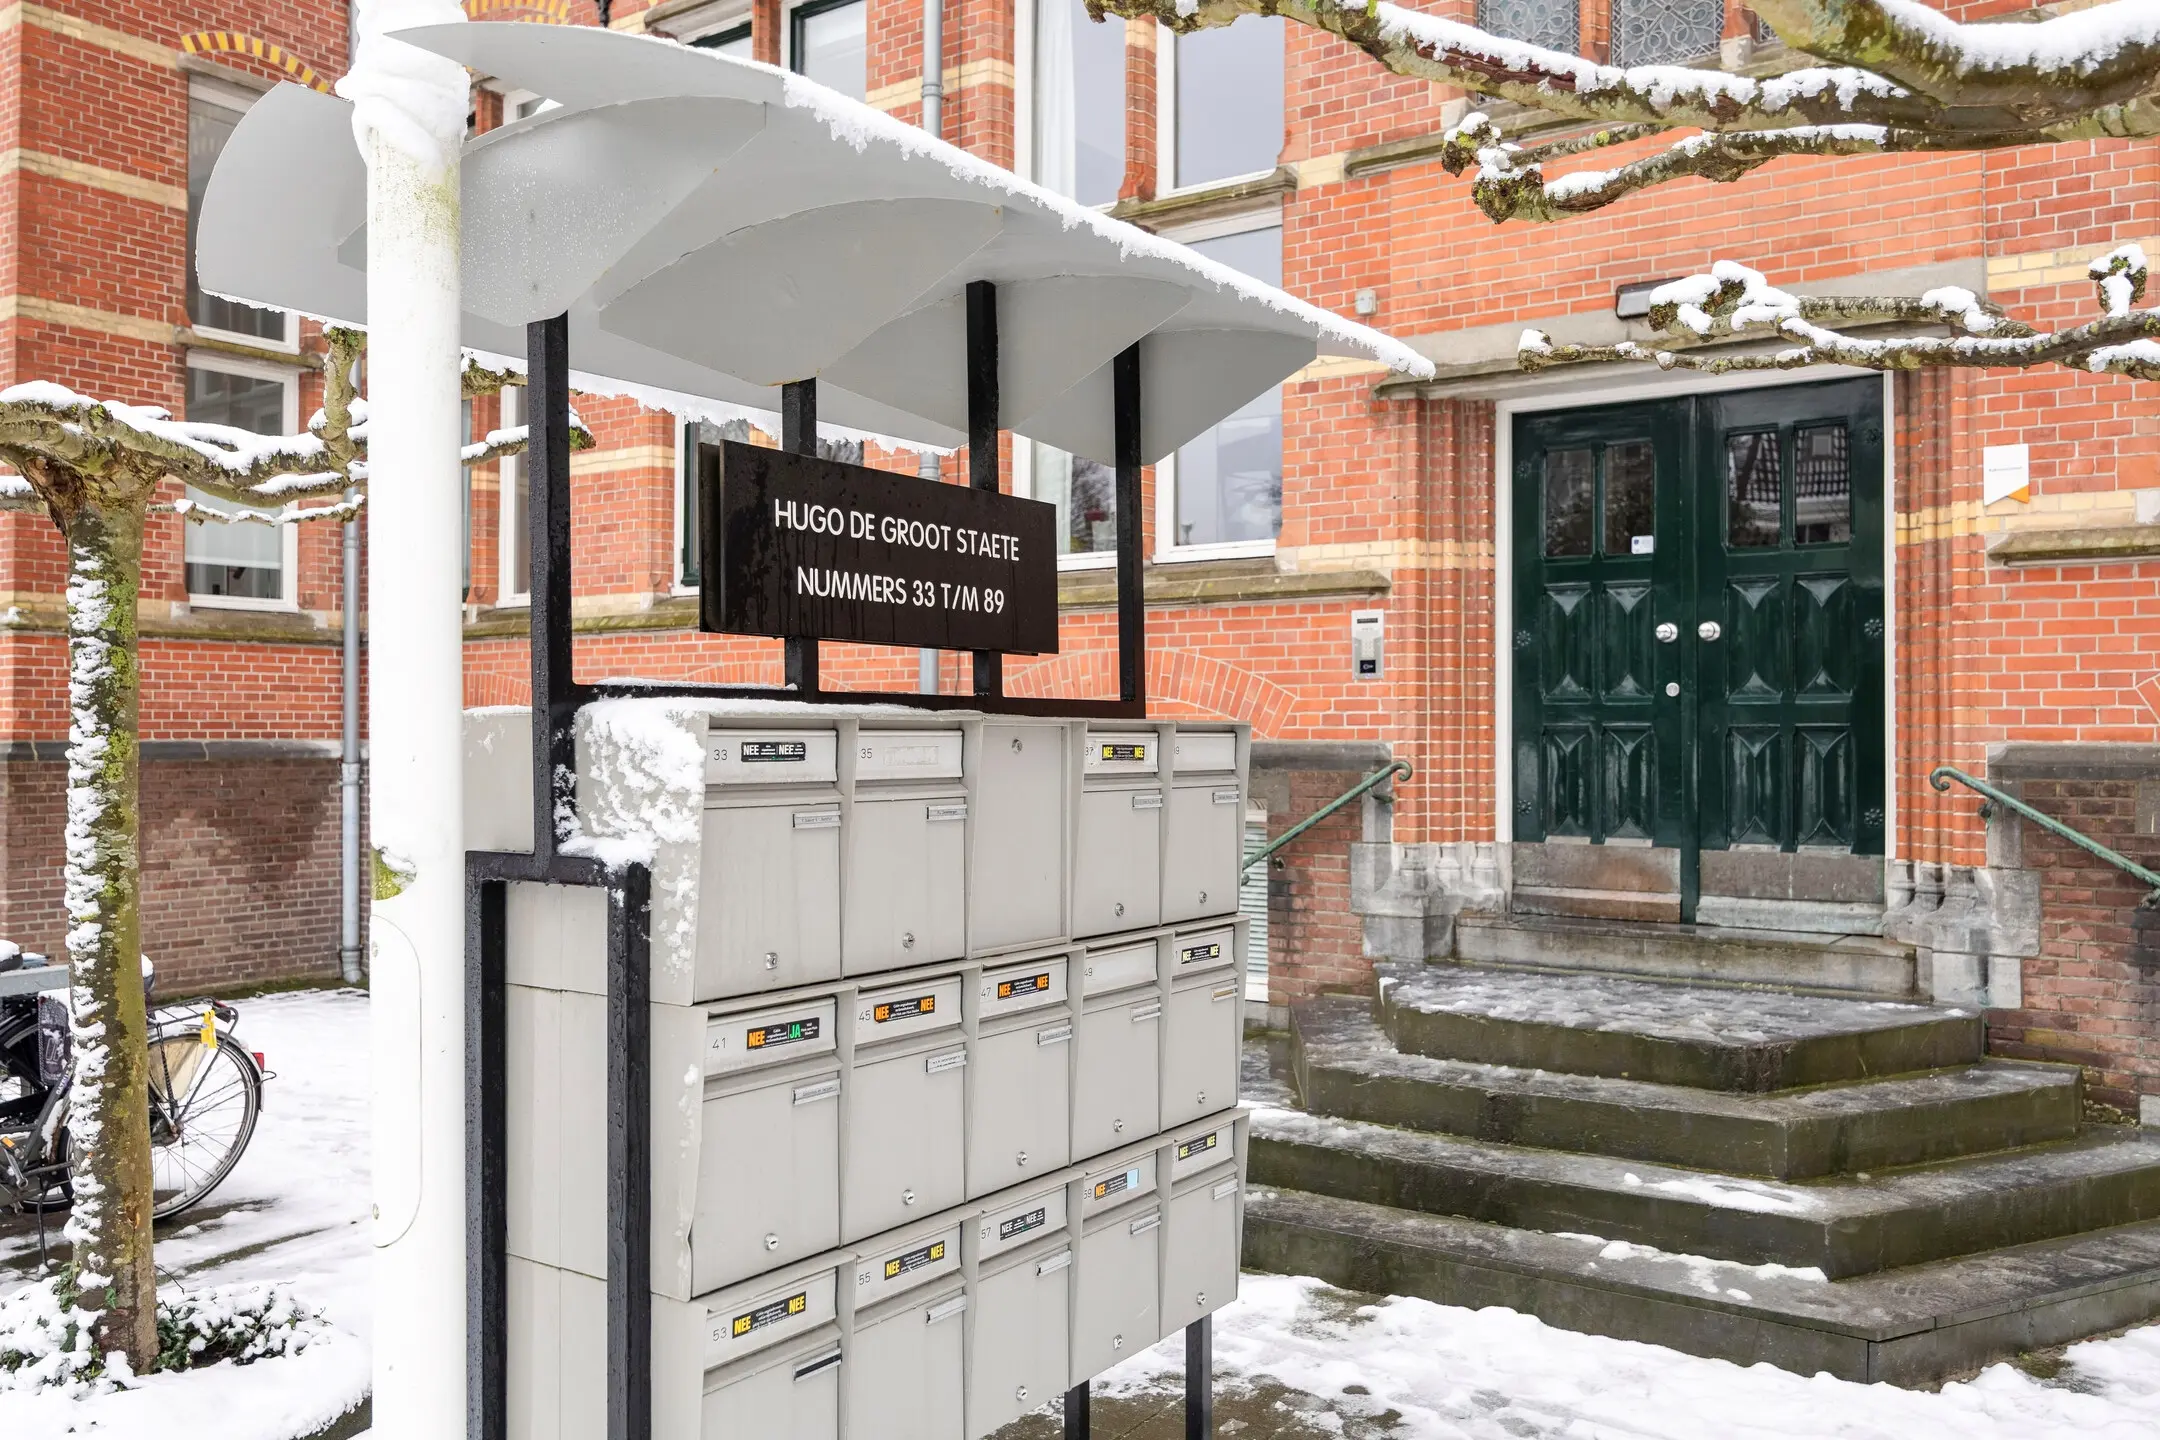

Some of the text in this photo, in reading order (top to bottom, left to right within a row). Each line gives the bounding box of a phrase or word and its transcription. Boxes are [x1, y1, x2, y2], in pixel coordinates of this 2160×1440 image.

[775, 498, 1020, 561] HUGO DE GROOT STAETE
[798, 566, 1005, 614] NUMMERS 33 T/M 89
[713, 749, 728, 761] 33
[743, 744, 760, 756] NEE
[778, 744, 794, 755] NEE
[860, 748, 873, 759] 35
[1103, 746, 1113, 758] NEE
[1134, 746, 1144, 758] NEE
[1182, 951, 1192, 962] NEE
[1209, 945, 1219, 956] NEE
[981, 986, 992, 998] 47
[999, 983, 1011, 997] NEE
[1037, 975, 1049, 989] NEE
[858, 1009, 871, 1021] 45
[875, 1005, 890, 1020] NEE
[920, 997, 934, 1012] NEE
[712, 1037, 727, 1050] 41
[748, 1030, 766, 1047] NEE
[790, 1024, 801, 1039] JA
[1179, 1146, 1189, 1159] NEE
[1206, 1135, 1216, 1148] NEE
[1095, 1183, 1106, 1198] NEE
[1001, 1221, 1013, 1234] NEE
[1026, 1212, 1037, 1225] NEE
[981, 1227, 992, 1240] 57
[886, 1259, 901, 1277] NEE
[930, 1243, 944, 1260] NEE
[858, 1271, 871, 1286] 55
[733, 1315, 752, 1336] NEE
[788, 1295, 805, 1314] NEE
[712, 1326, 728, 1342] 53
